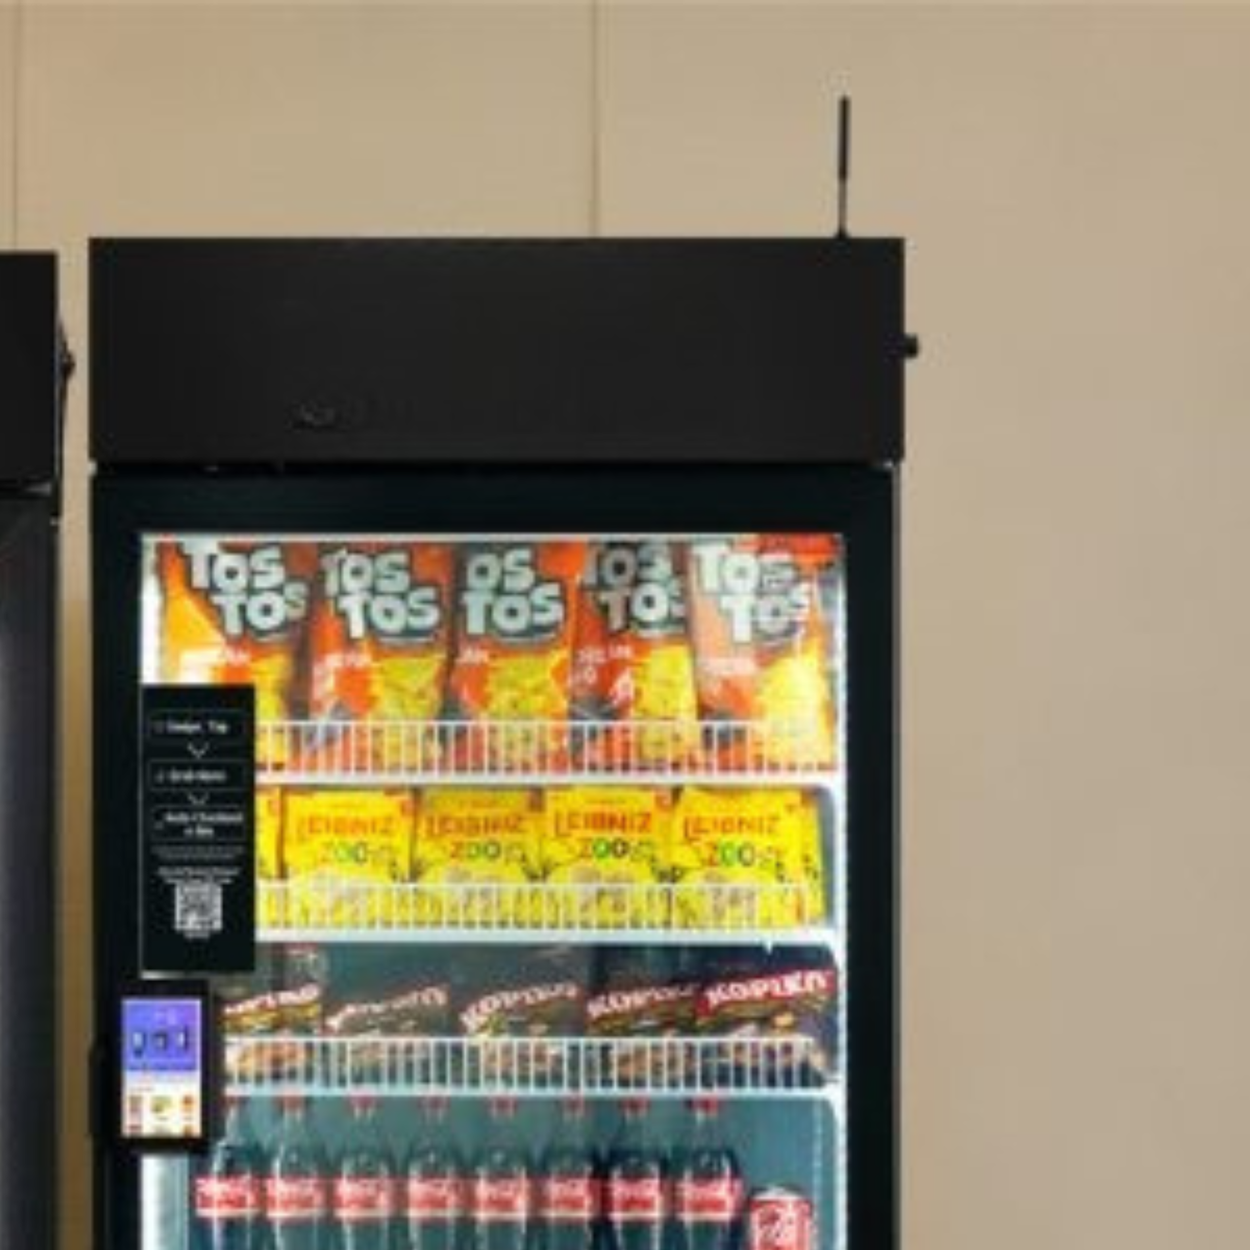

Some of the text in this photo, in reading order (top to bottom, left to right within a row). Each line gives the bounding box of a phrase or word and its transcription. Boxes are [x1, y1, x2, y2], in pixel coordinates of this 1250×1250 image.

[180, 540, 286, 594] TOS
[337, 587, 440, 640] TOS
[461, 582, 565, 636] TOS
[554, 810, 653, 839] LEIBNIZ
[684, 815, 781, 841] LEIBNIZ
